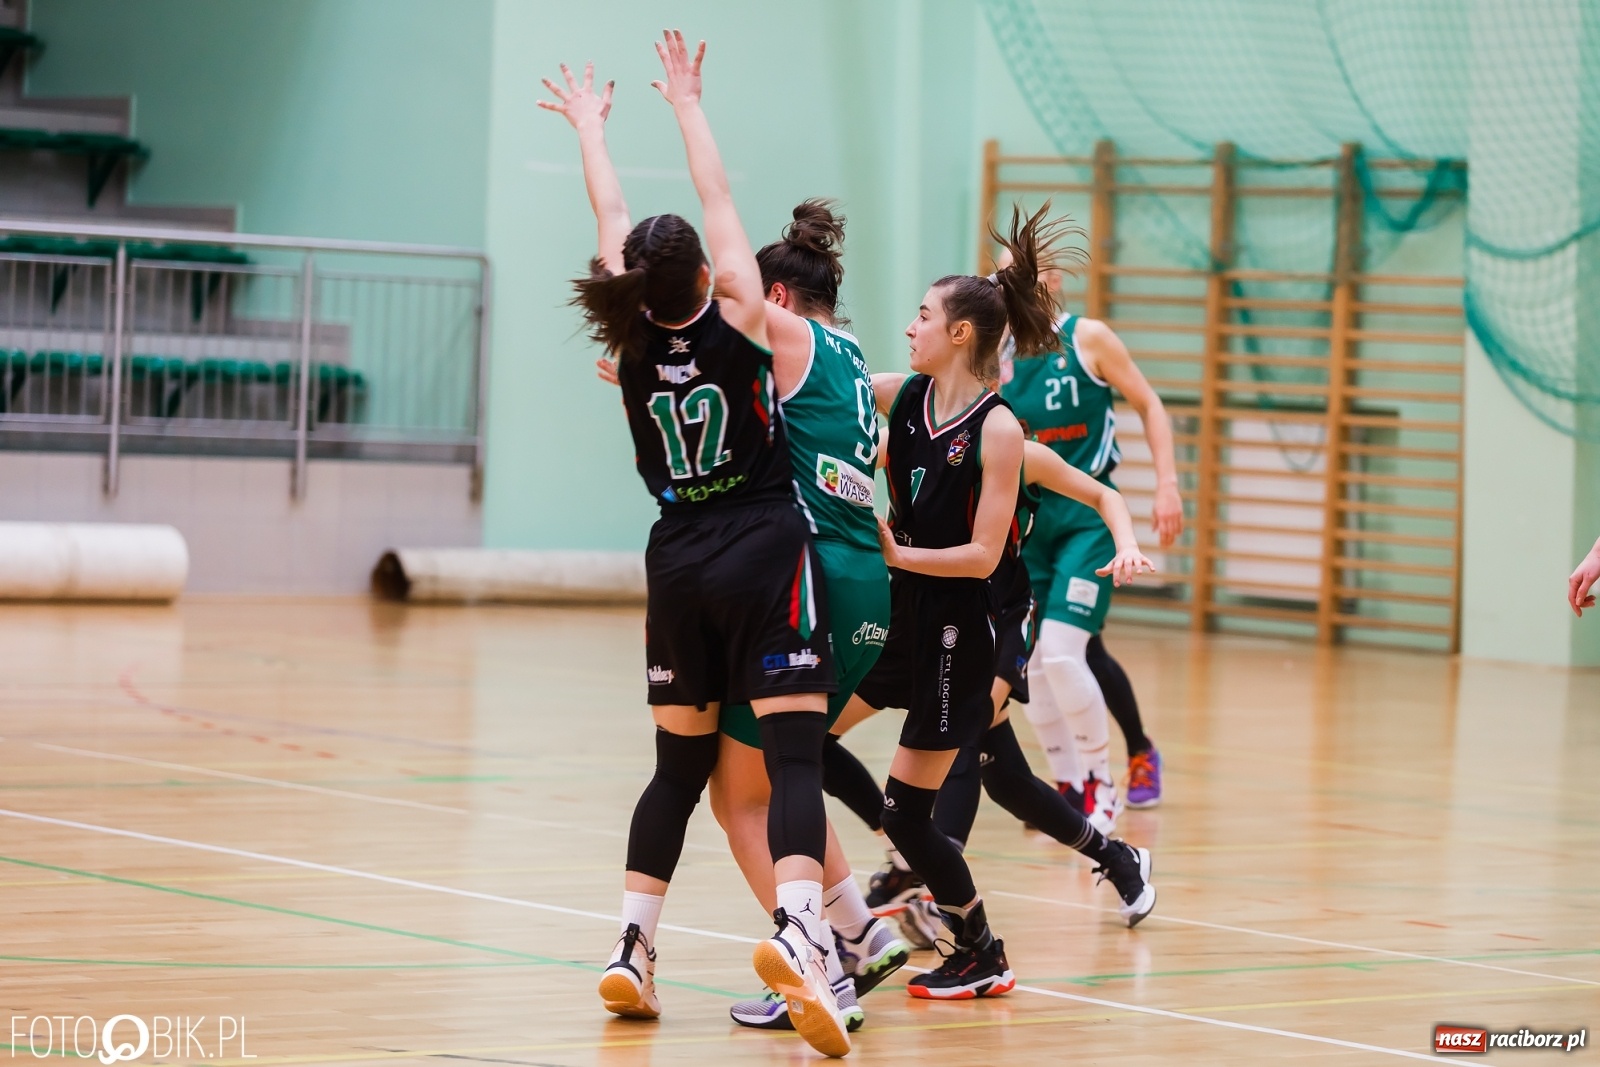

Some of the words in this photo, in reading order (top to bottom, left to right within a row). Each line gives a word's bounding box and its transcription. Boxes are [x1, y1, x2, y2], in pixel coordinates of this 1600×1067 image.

[1045, 375, 1079, 410] 27
[647, 383, 732, 480] 12
[911, 466, 926, 507] 1
[762, 654, 788, 669] CTL
[944, 654, 952, 674] CTL
[940, 678, 951, 732] LOGISTICS
